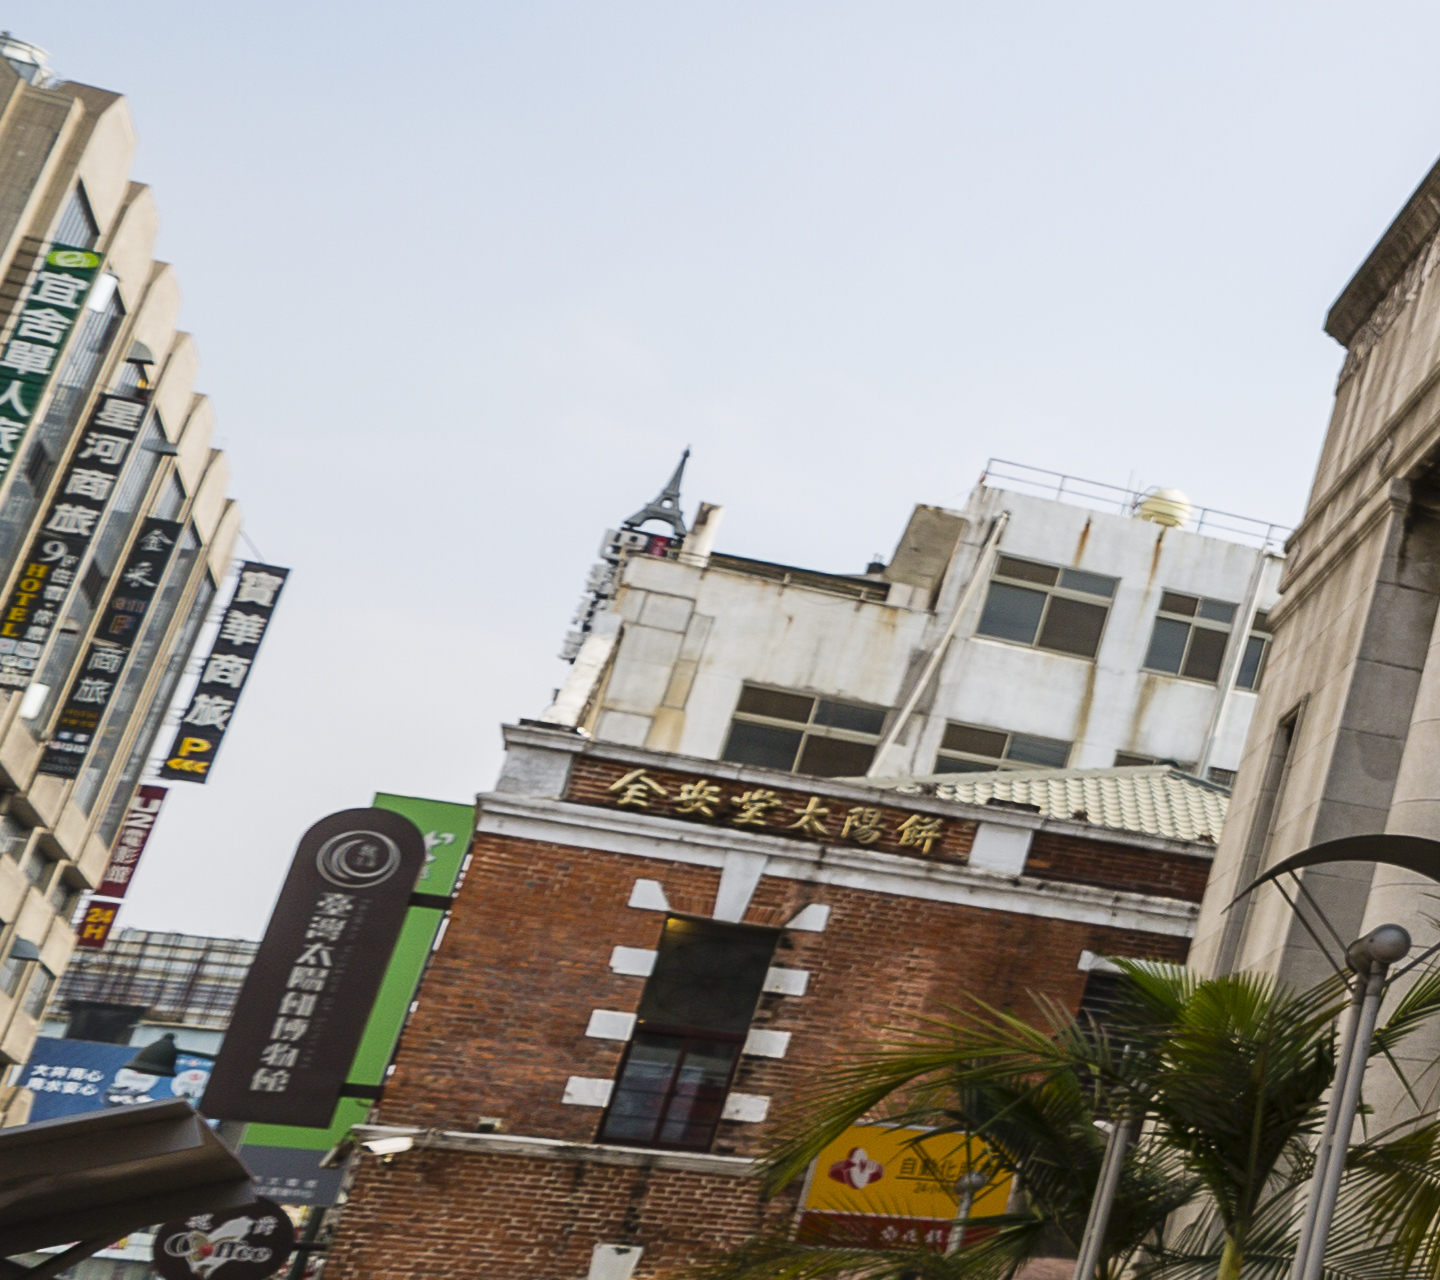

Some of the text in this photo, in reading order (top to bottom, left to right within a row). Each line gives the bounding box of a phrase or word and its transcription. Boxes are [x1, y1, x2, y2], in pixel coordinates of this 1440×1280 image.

[46, 399, 144, 536] 星河商旅
[1, 562, 50, 638] HOTEL
[183, 571, 283, 732] 寶華商旅
[178, 737, 212, 757] P
[88, 907, 115, 924] 24
[250, 892, 355, 1093] 臺灣太陽餅博物館
